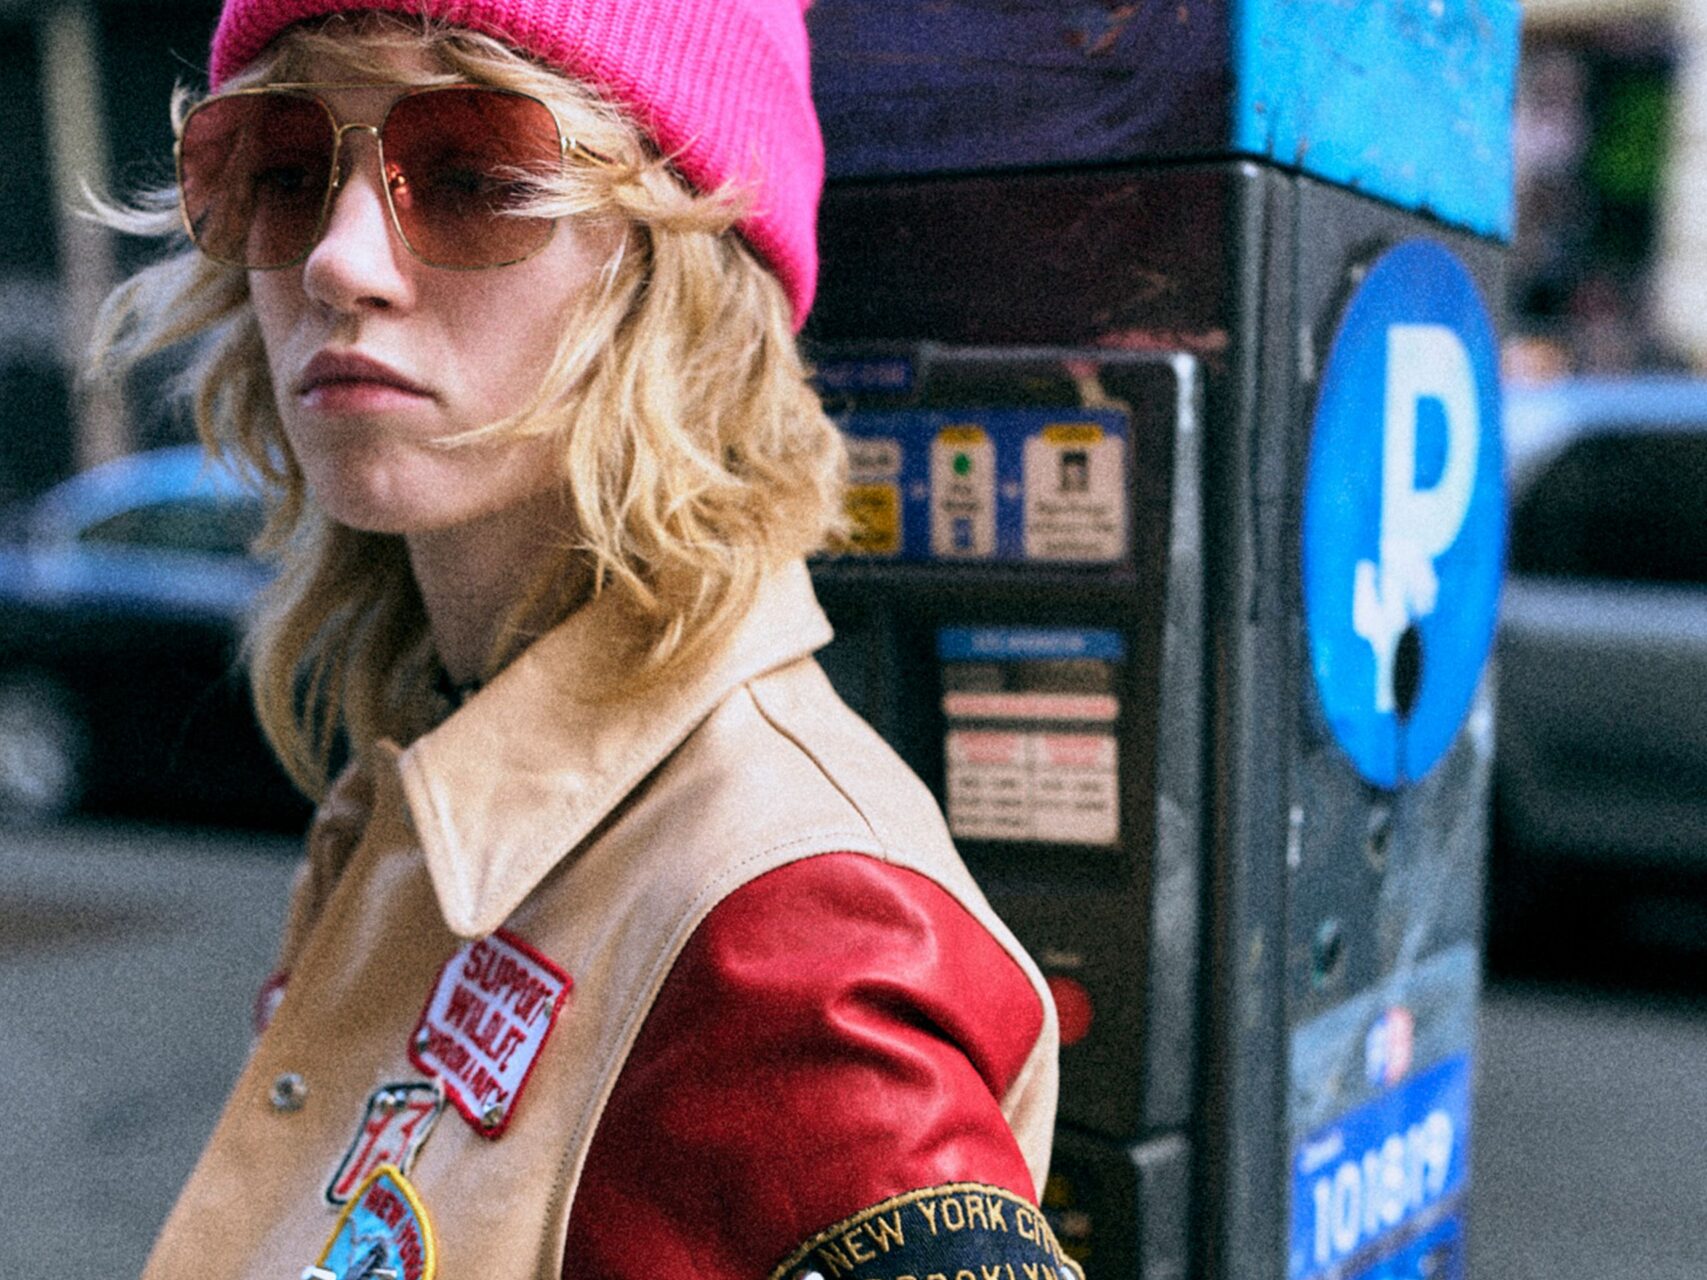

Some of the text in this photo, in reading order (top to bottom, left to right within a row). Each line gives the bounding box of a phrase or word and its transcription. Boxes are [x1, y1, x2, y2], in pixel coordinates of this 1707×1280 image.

[463, 940, 554, 1028] SUPPORT
[818, 1210, 905, 1279] NEW
[917, 1195, 1009, 1237] YORK
